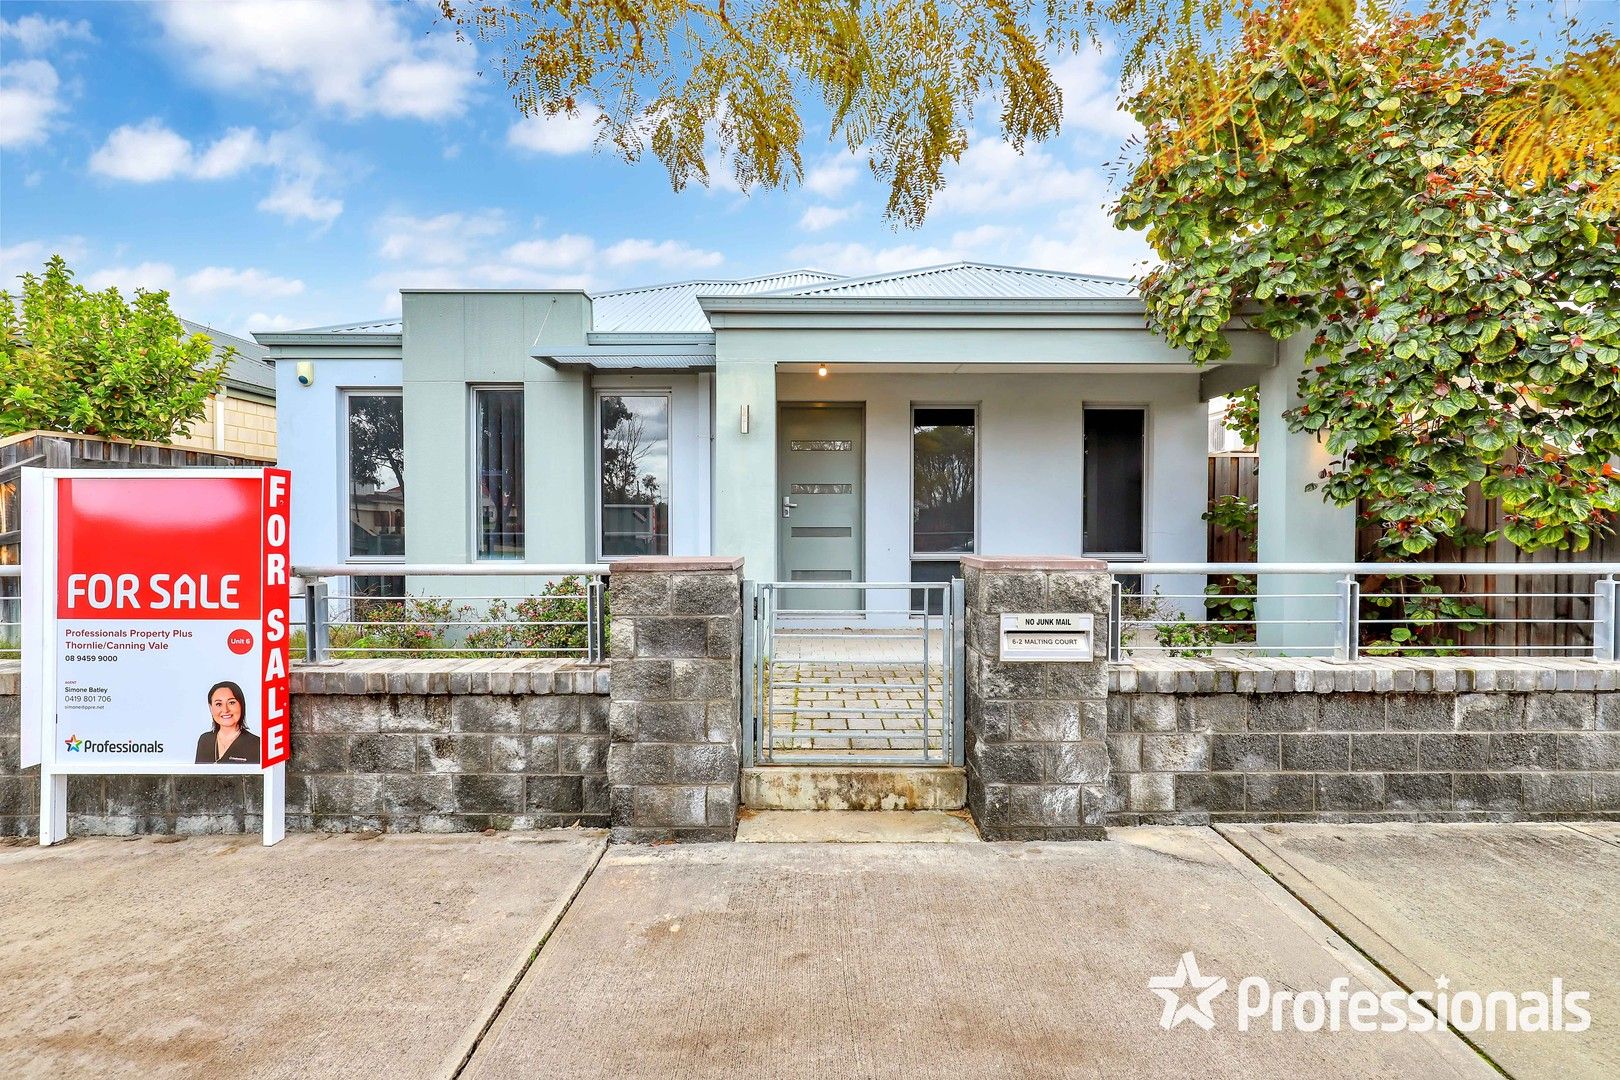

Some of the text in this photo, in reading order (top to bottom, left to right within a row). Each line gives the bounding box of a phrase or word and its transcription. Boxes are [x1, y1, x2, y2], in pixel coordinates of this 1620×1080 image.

[67, 574, 240, 609] FOR SALE
[265, 475, 286, 761] FOR SALE
[65, 629, 193, 639] Professionals Property Plus
[65, 641, 169, 651] Thornlie/Canning Vale
[84, 740, 164, 753] Professionals
